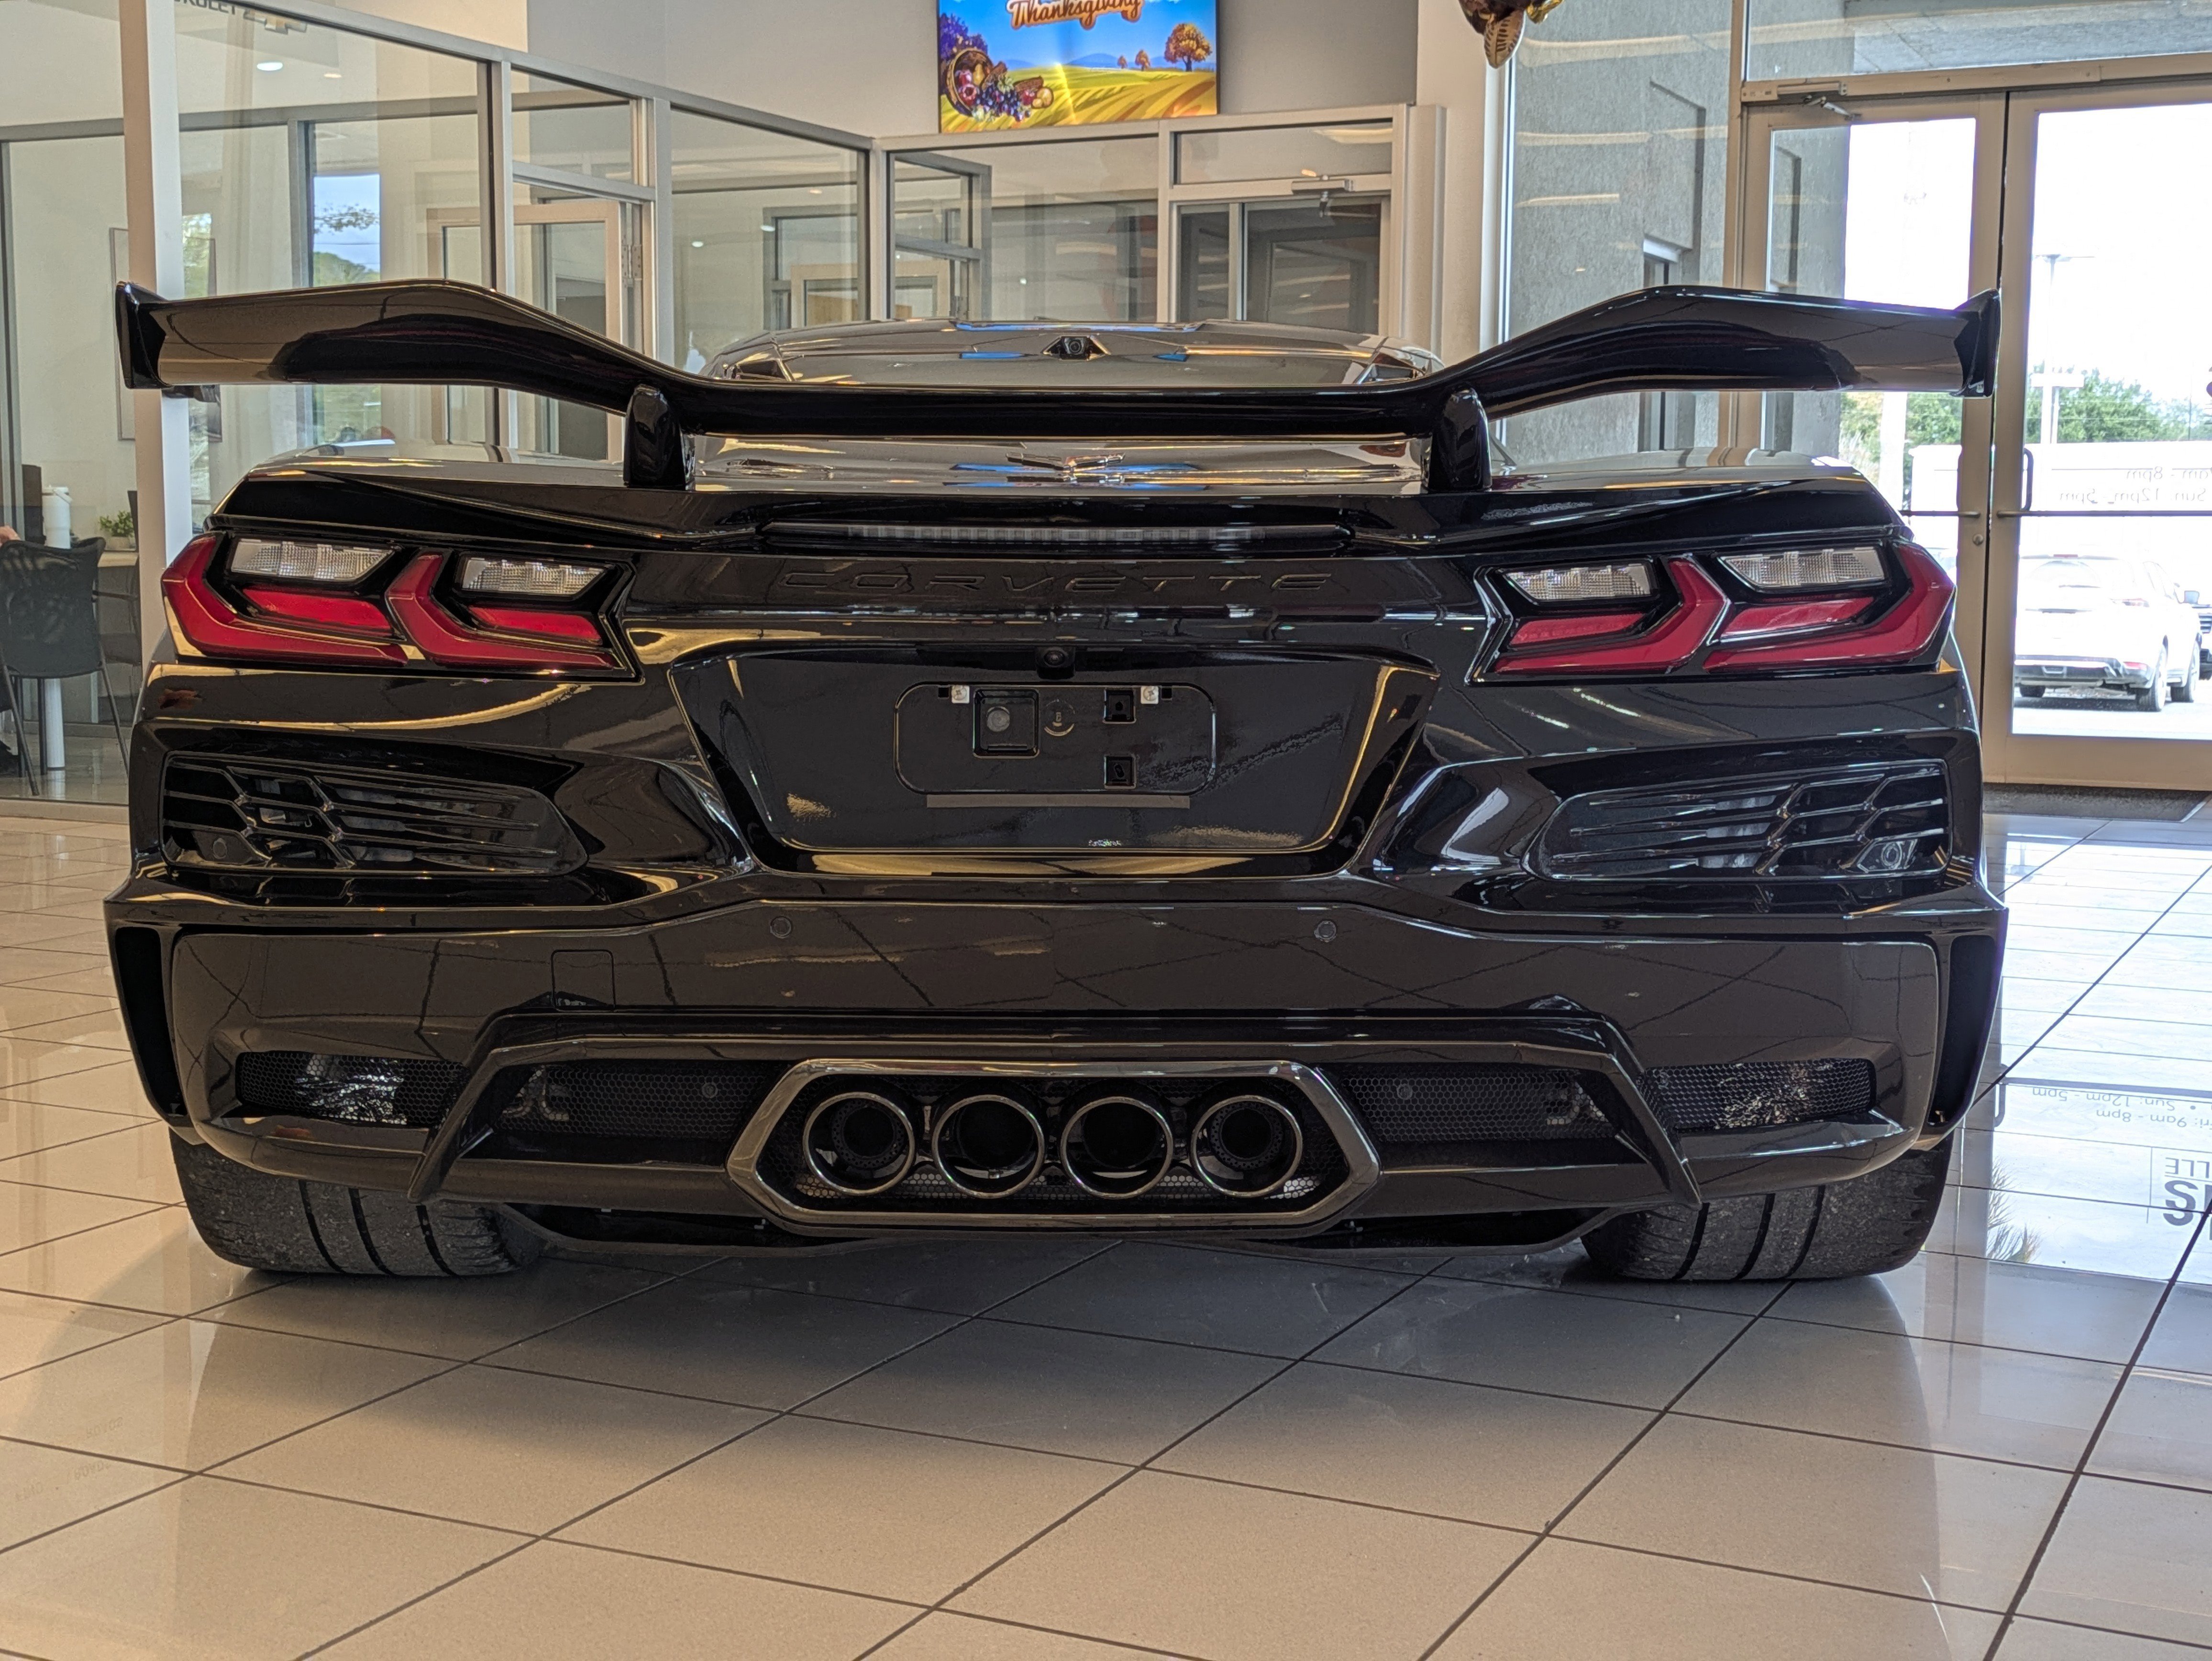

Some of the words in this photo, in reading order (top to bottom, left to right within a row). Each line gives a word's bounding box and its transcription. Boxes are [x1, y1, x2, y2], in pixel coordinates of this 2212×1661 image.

[1008, 0, 1142, 27] Thanksgiving
[777, 572, 1331, 592] CORVETTE
[2032, 1087, 2068, 1102] 5pm
[2086, 1093, 2130, 1107] 12pm
[2140, 1097, 2176, 1111] Sun:
[2096, 1109, 2132, 1123] 8pm
[2150, 1114, 2187, 1128] 9am
